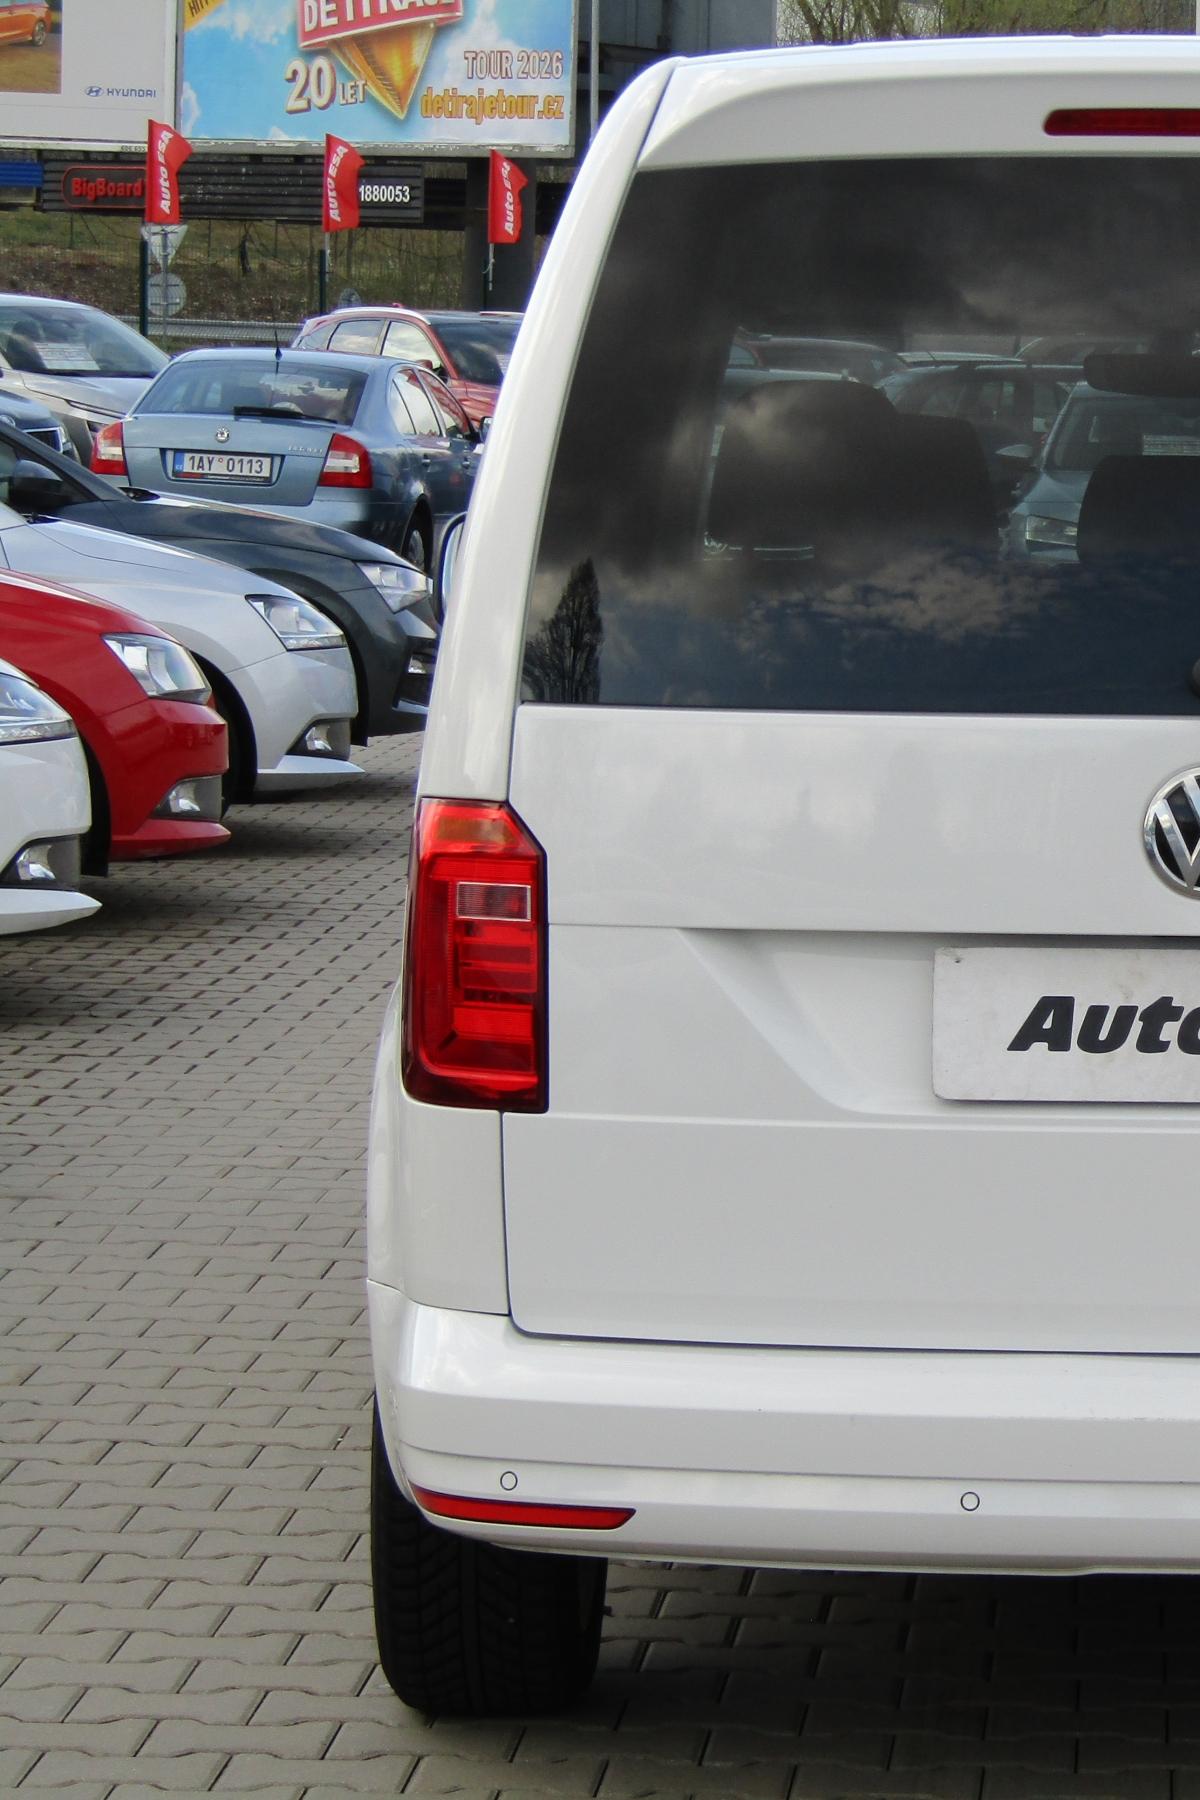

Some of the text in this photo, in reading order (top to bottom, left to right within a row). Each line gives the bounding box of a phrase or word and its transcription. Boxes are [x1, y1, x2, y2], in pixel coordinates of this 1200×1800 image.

[464, 50, 564, 80] TOUR 2026
[106, 87, 157, 99] HYUNDAI
[284, 56, 368, 115] 20 LET
[420, 86, 565, 126] detirajetour.cz
[71, 177, 145, 201] BigBoard
[160, 167, 172, 215] Auto
[326, 145, 349, 223] Auto ESA
[503, 191, 514, 236] Auto
[188, 455, 215, 472] 1AY
[226, 457, 264, 474] 0113
